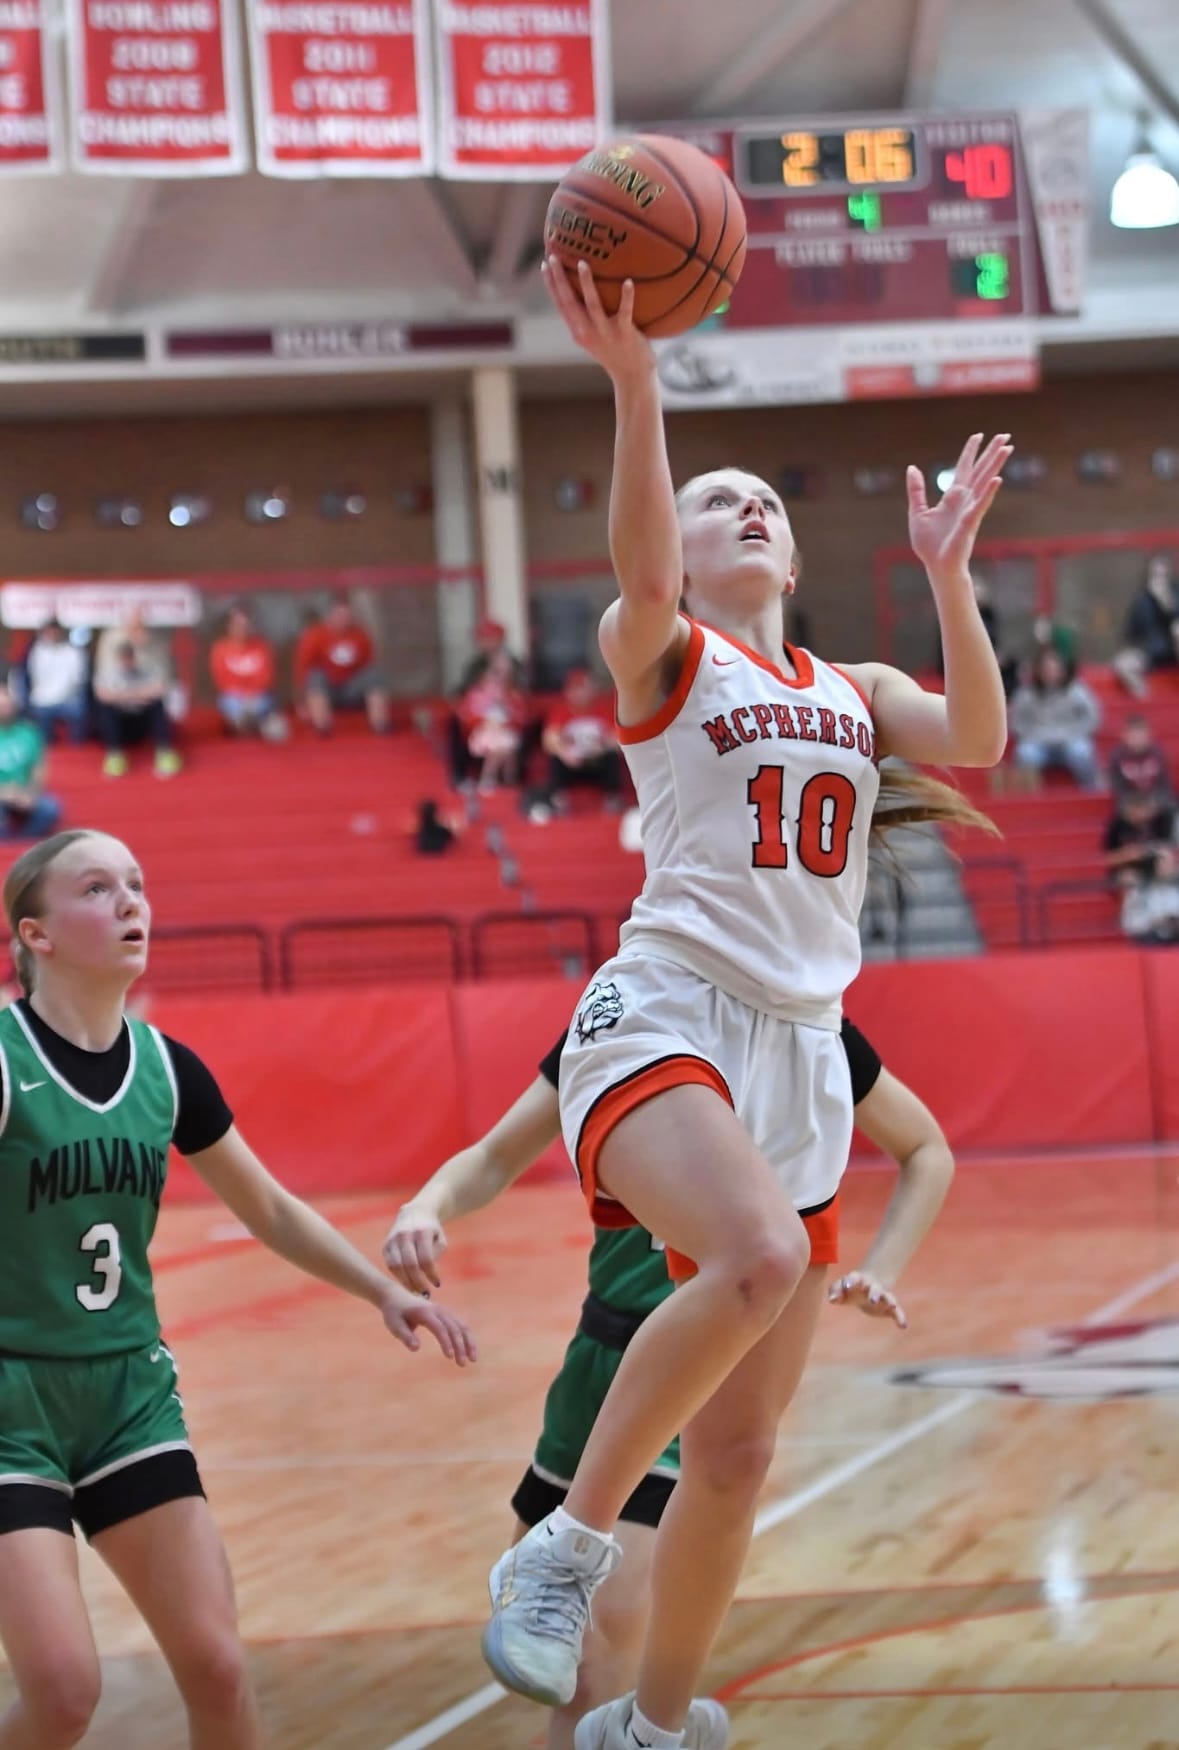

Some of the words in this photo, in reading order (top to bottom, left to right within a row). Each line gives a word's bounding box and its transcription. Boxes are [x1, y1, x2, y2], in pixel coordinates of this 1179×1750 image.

[88, 2, 214, 32] BOWLING
[258, 4, 415, 35] BASKETBALL
[442, 5, 594, 36] BASKETBALL
[106, 74, 204, 109] STATE
[291, 77, 390, 112] STATE
[474, 80, 571, 113] STATE
[79, 113, 231, 147] CHAMPIONS
[265, 115, 421, 149] CHAMPIONS
[452, 118, 597, 151] CHAMPIONS
[945, 144, 1013, 200] 40
[848, 188, 882, 232] 4
[748, 765, 857, 878] 10
[76, 1222, 121, 1311] 3
